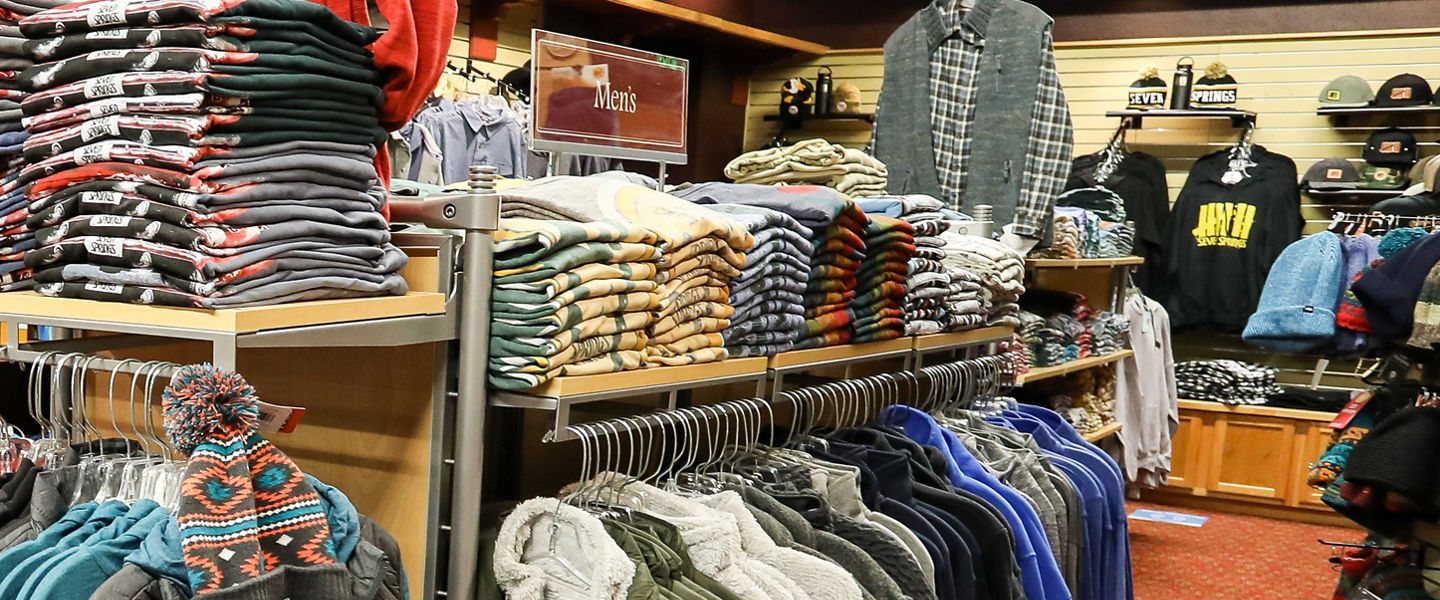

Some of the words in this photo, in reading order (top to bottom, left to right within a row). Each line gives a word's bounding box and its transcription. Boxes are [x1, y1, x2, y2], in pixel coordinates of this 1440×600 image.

[593, 79, 637, 114] Men's
[1129, 92, 1164, 105] SEVEN
[1190, 90, 1236, 103] SPRINGS
